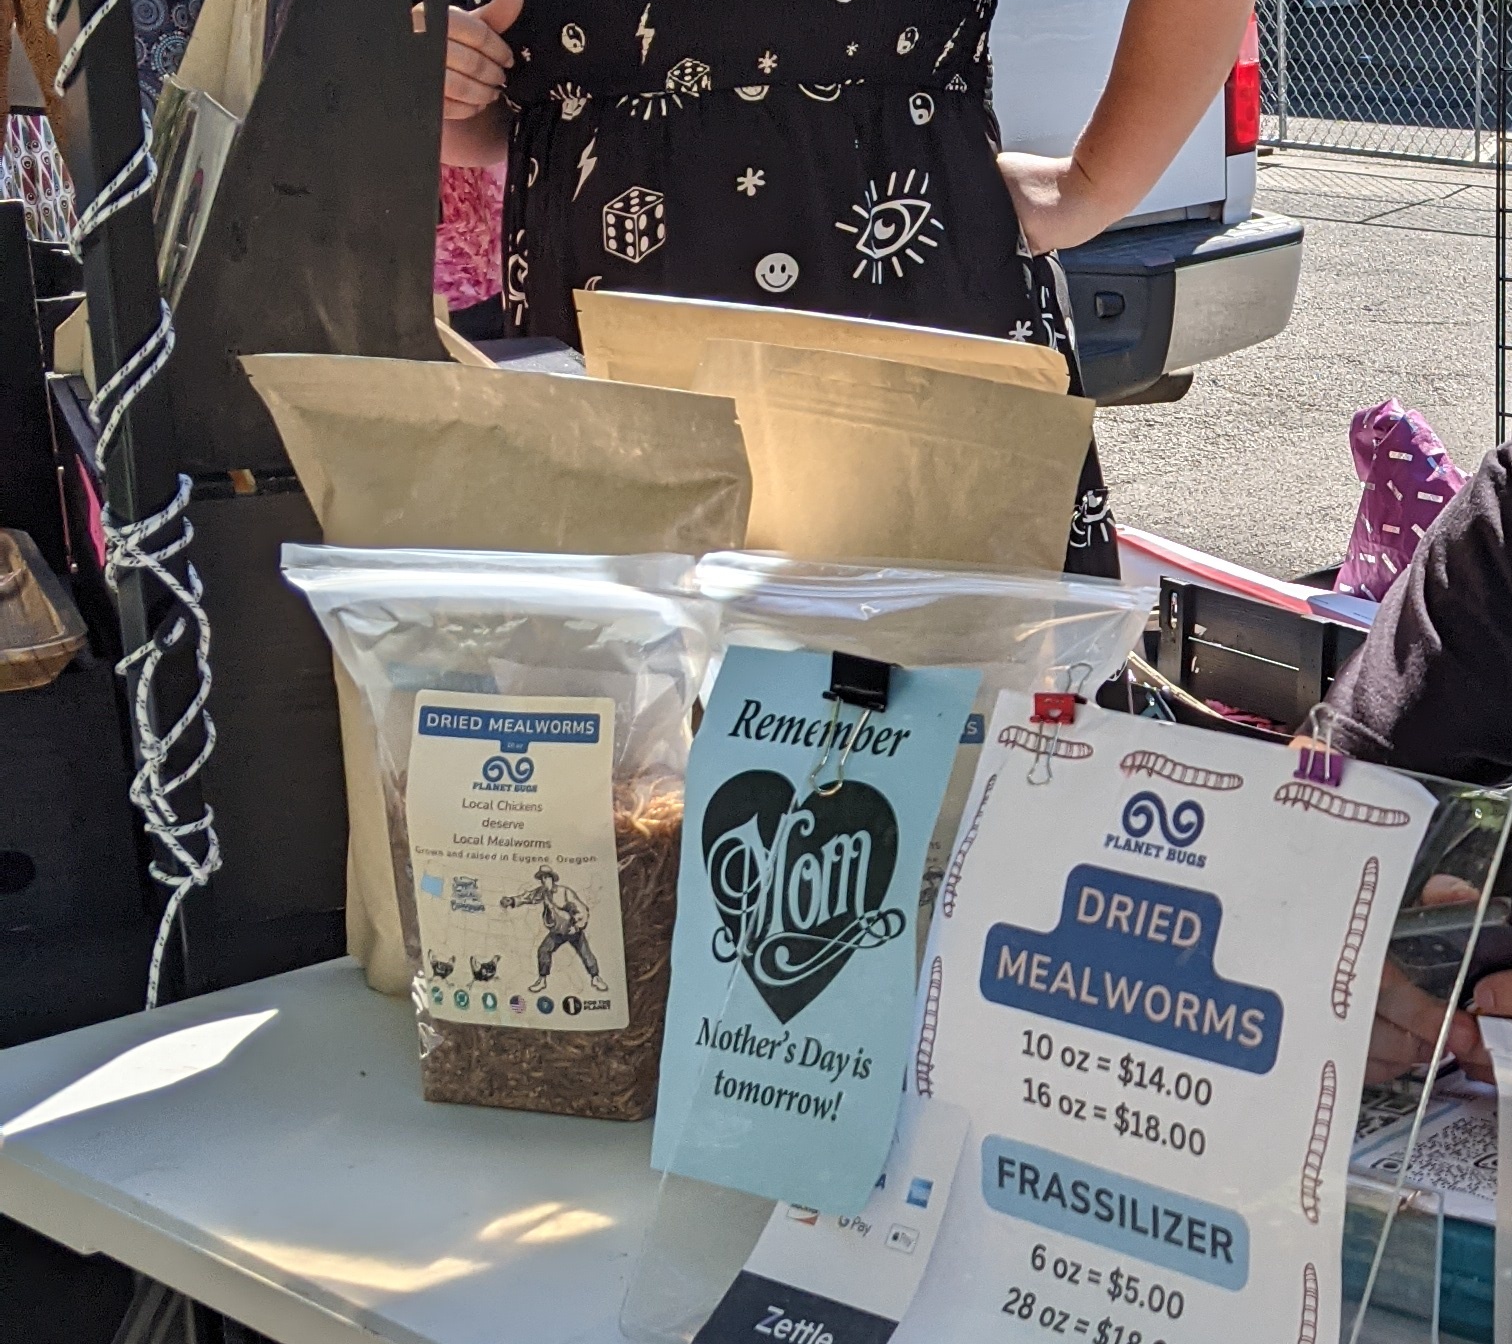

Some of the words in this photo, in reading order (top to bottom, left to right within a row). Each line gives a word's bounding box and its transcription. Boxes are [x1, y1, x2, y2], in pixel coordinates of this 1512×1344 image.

[426, 712, 483, 731] DRIED
[488, 717, 595, 736] MEALWORMS
[728, 699, 911, 757] Remember
[462, 797, 494, 811] Local
[497, 800, 544, 813] Chickens
[481, 816, 525, 830] deserve
[446, 847, 463, 858] and
[466, 848, 497, 860] raised
[500, 850, 509, 860] in
[453, 832, 484, 846] Local
[487, 834, 552, 850] Mealworms
[1104, 834, 1164, 859] PLANET
[1166, 847, 1207, 868] BUGS
[708, 808, 905, 985] Mom
[1076, 886, 1202, 949] DRIED
[996, 944, 1266, 1049] MEALWORMS
[696, 1016, 798, 1062] Mother's
[799, 1037, 850, 1083] Day
[853, 1048, 873, 1079] is
[1021, 1029, 1053, 1061] 10
[1060, 1046, 1090, 1072] oz
[1097, 1056, 1111, 1072] =
[1118, 1053, 1212, 1106] $14.00
[713, 1068, 844, 1122] tomorrow!
[1022, 1078, 1052, 1108] 16
[1058, 1094, 1087, 1121] oz
[1093, 1105, 1108, 1120] =
[1113, 1101, 1206, 1156] $18.00
[851, 1215, 873, 1238] Pay
[997, 1155, 1235, 1264] FRASSILIZER
[1031, 1243, 1047, 1272] 6
[1053, 1257, 1082, 1285] oz
[1088, 1267, 1102, 1286] =
[1107, 1267, 1185, 1320] $5.00
[1002, 1287, 1037, 1320] 28
[1039, 1305, 1070, 1334] oz
[1074, 1317, 1090, 1334] =
